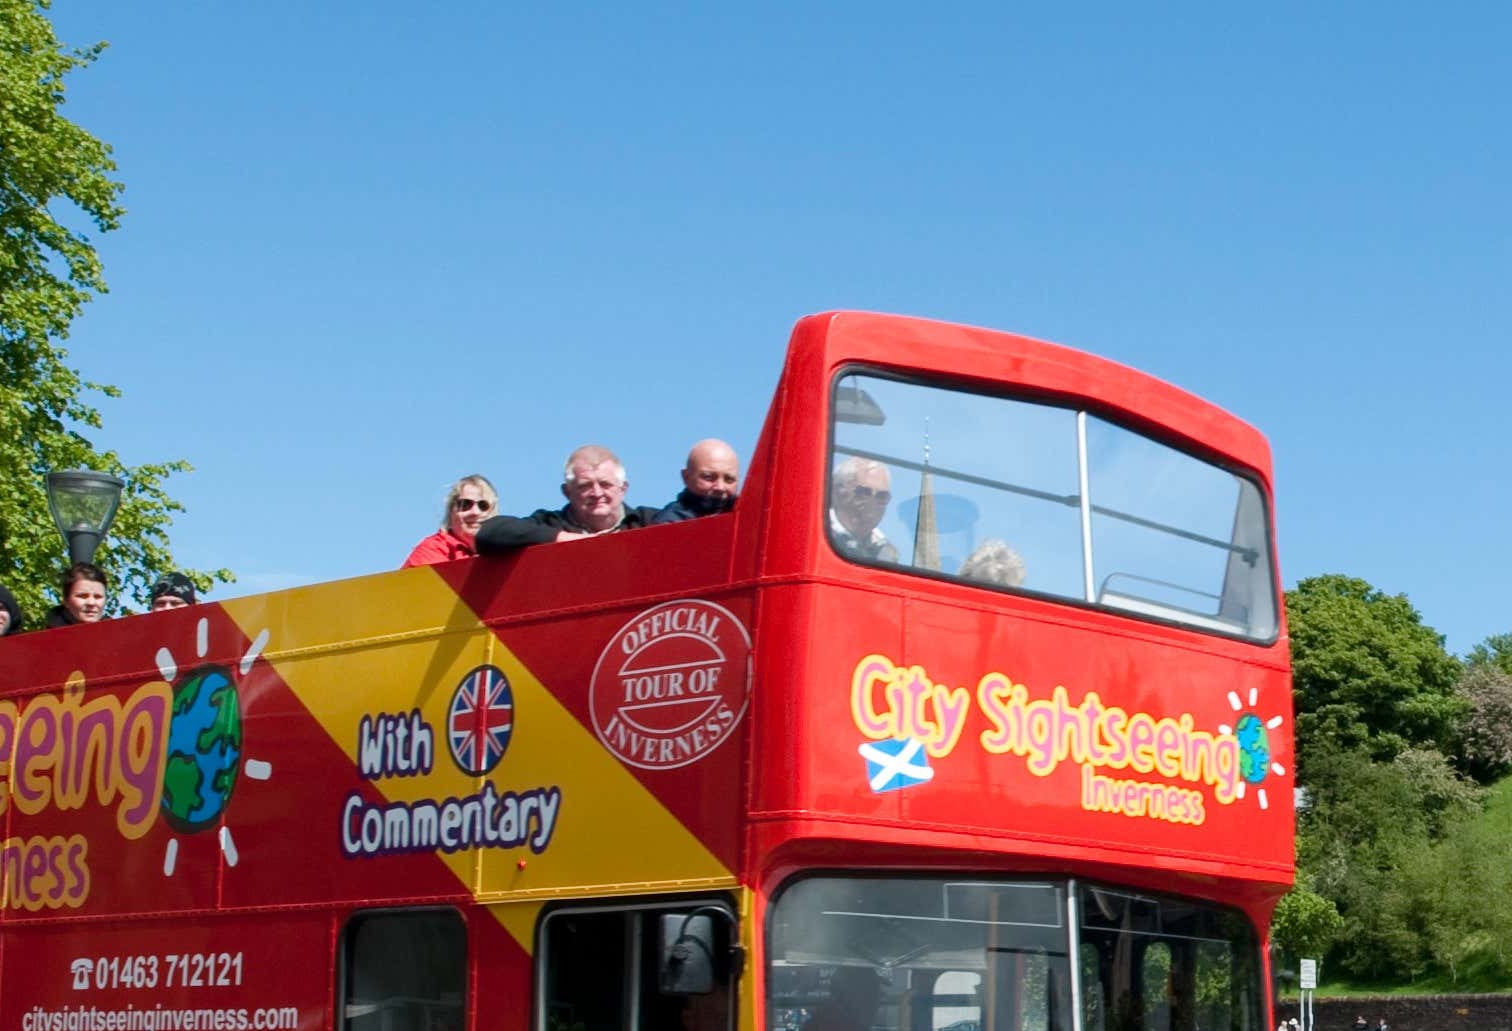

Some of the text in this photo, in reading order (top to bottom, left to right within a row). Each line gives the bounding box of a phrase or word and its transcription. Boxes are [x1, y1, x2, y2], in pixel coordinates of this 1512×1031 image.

[621, 607, 721, 656] OFFICIAL
[622, 666, 721, 701] TOUR OF
[359, 709, 433, 779] With
[603, 702, 734, 763] INVERNESS
[850, 654, 1239, 806] City Sightseeing
[341, 781, 561, 859] Commentary
[1082, 763, 1205, 825] Inverness
[96, 952, 243, 989] 01463 712121
